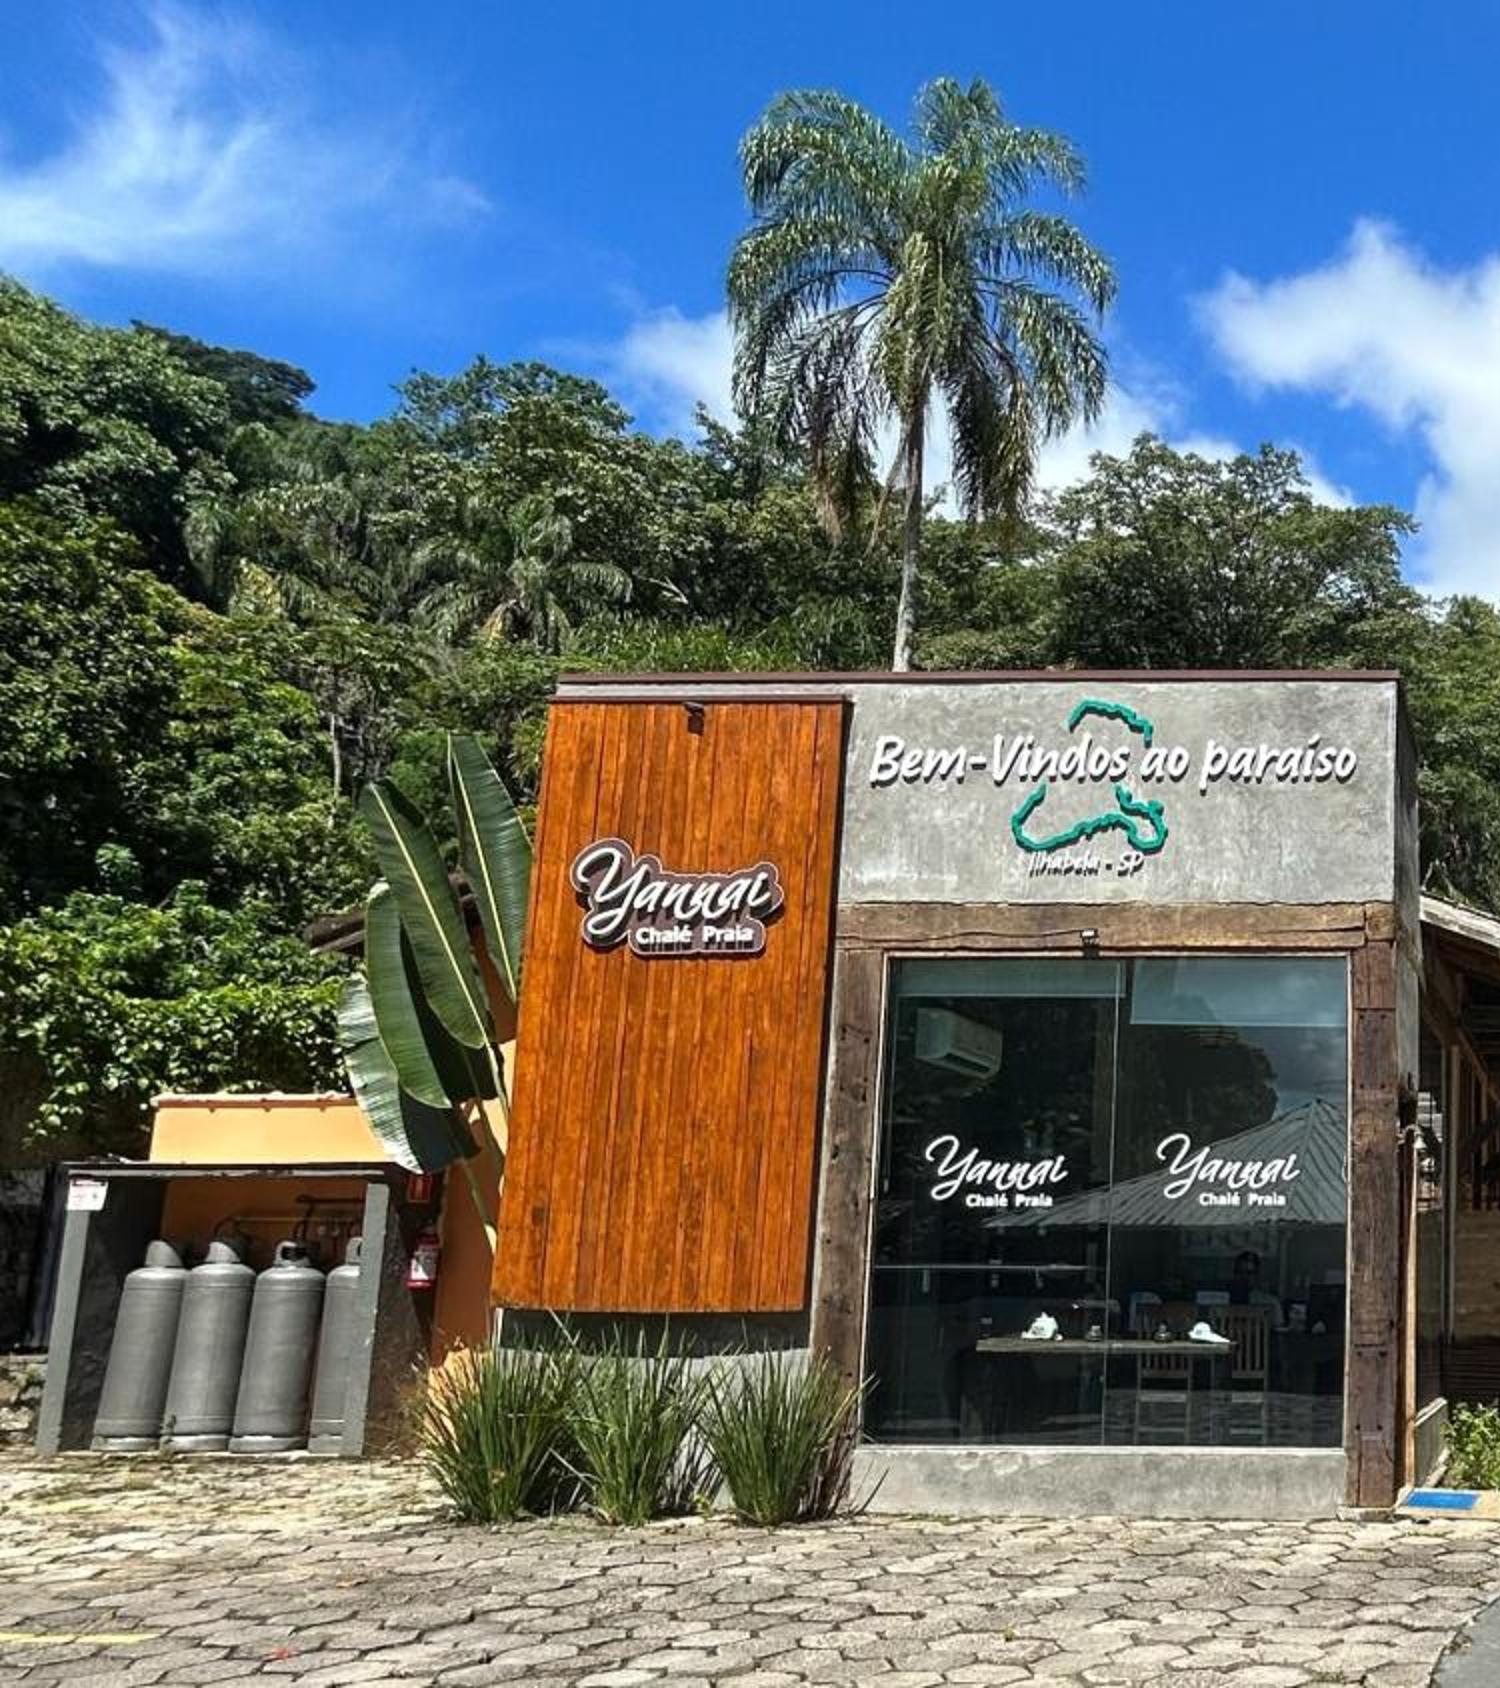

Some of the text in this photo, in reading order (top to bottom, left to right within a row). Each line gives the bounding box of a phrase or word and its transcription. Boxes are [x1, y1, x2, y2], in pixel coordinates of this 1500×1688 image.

[869, 733, 1358, 796] Bem-Vindos ao paraíso
[1116, 851, 1145, 877] SP
[635, 924, 755, 945] Chalé Praia
[965, 1193, 1053, 1207] Chalé Praia
[1199, 1192, 1286, 1206] Chalé Praia
